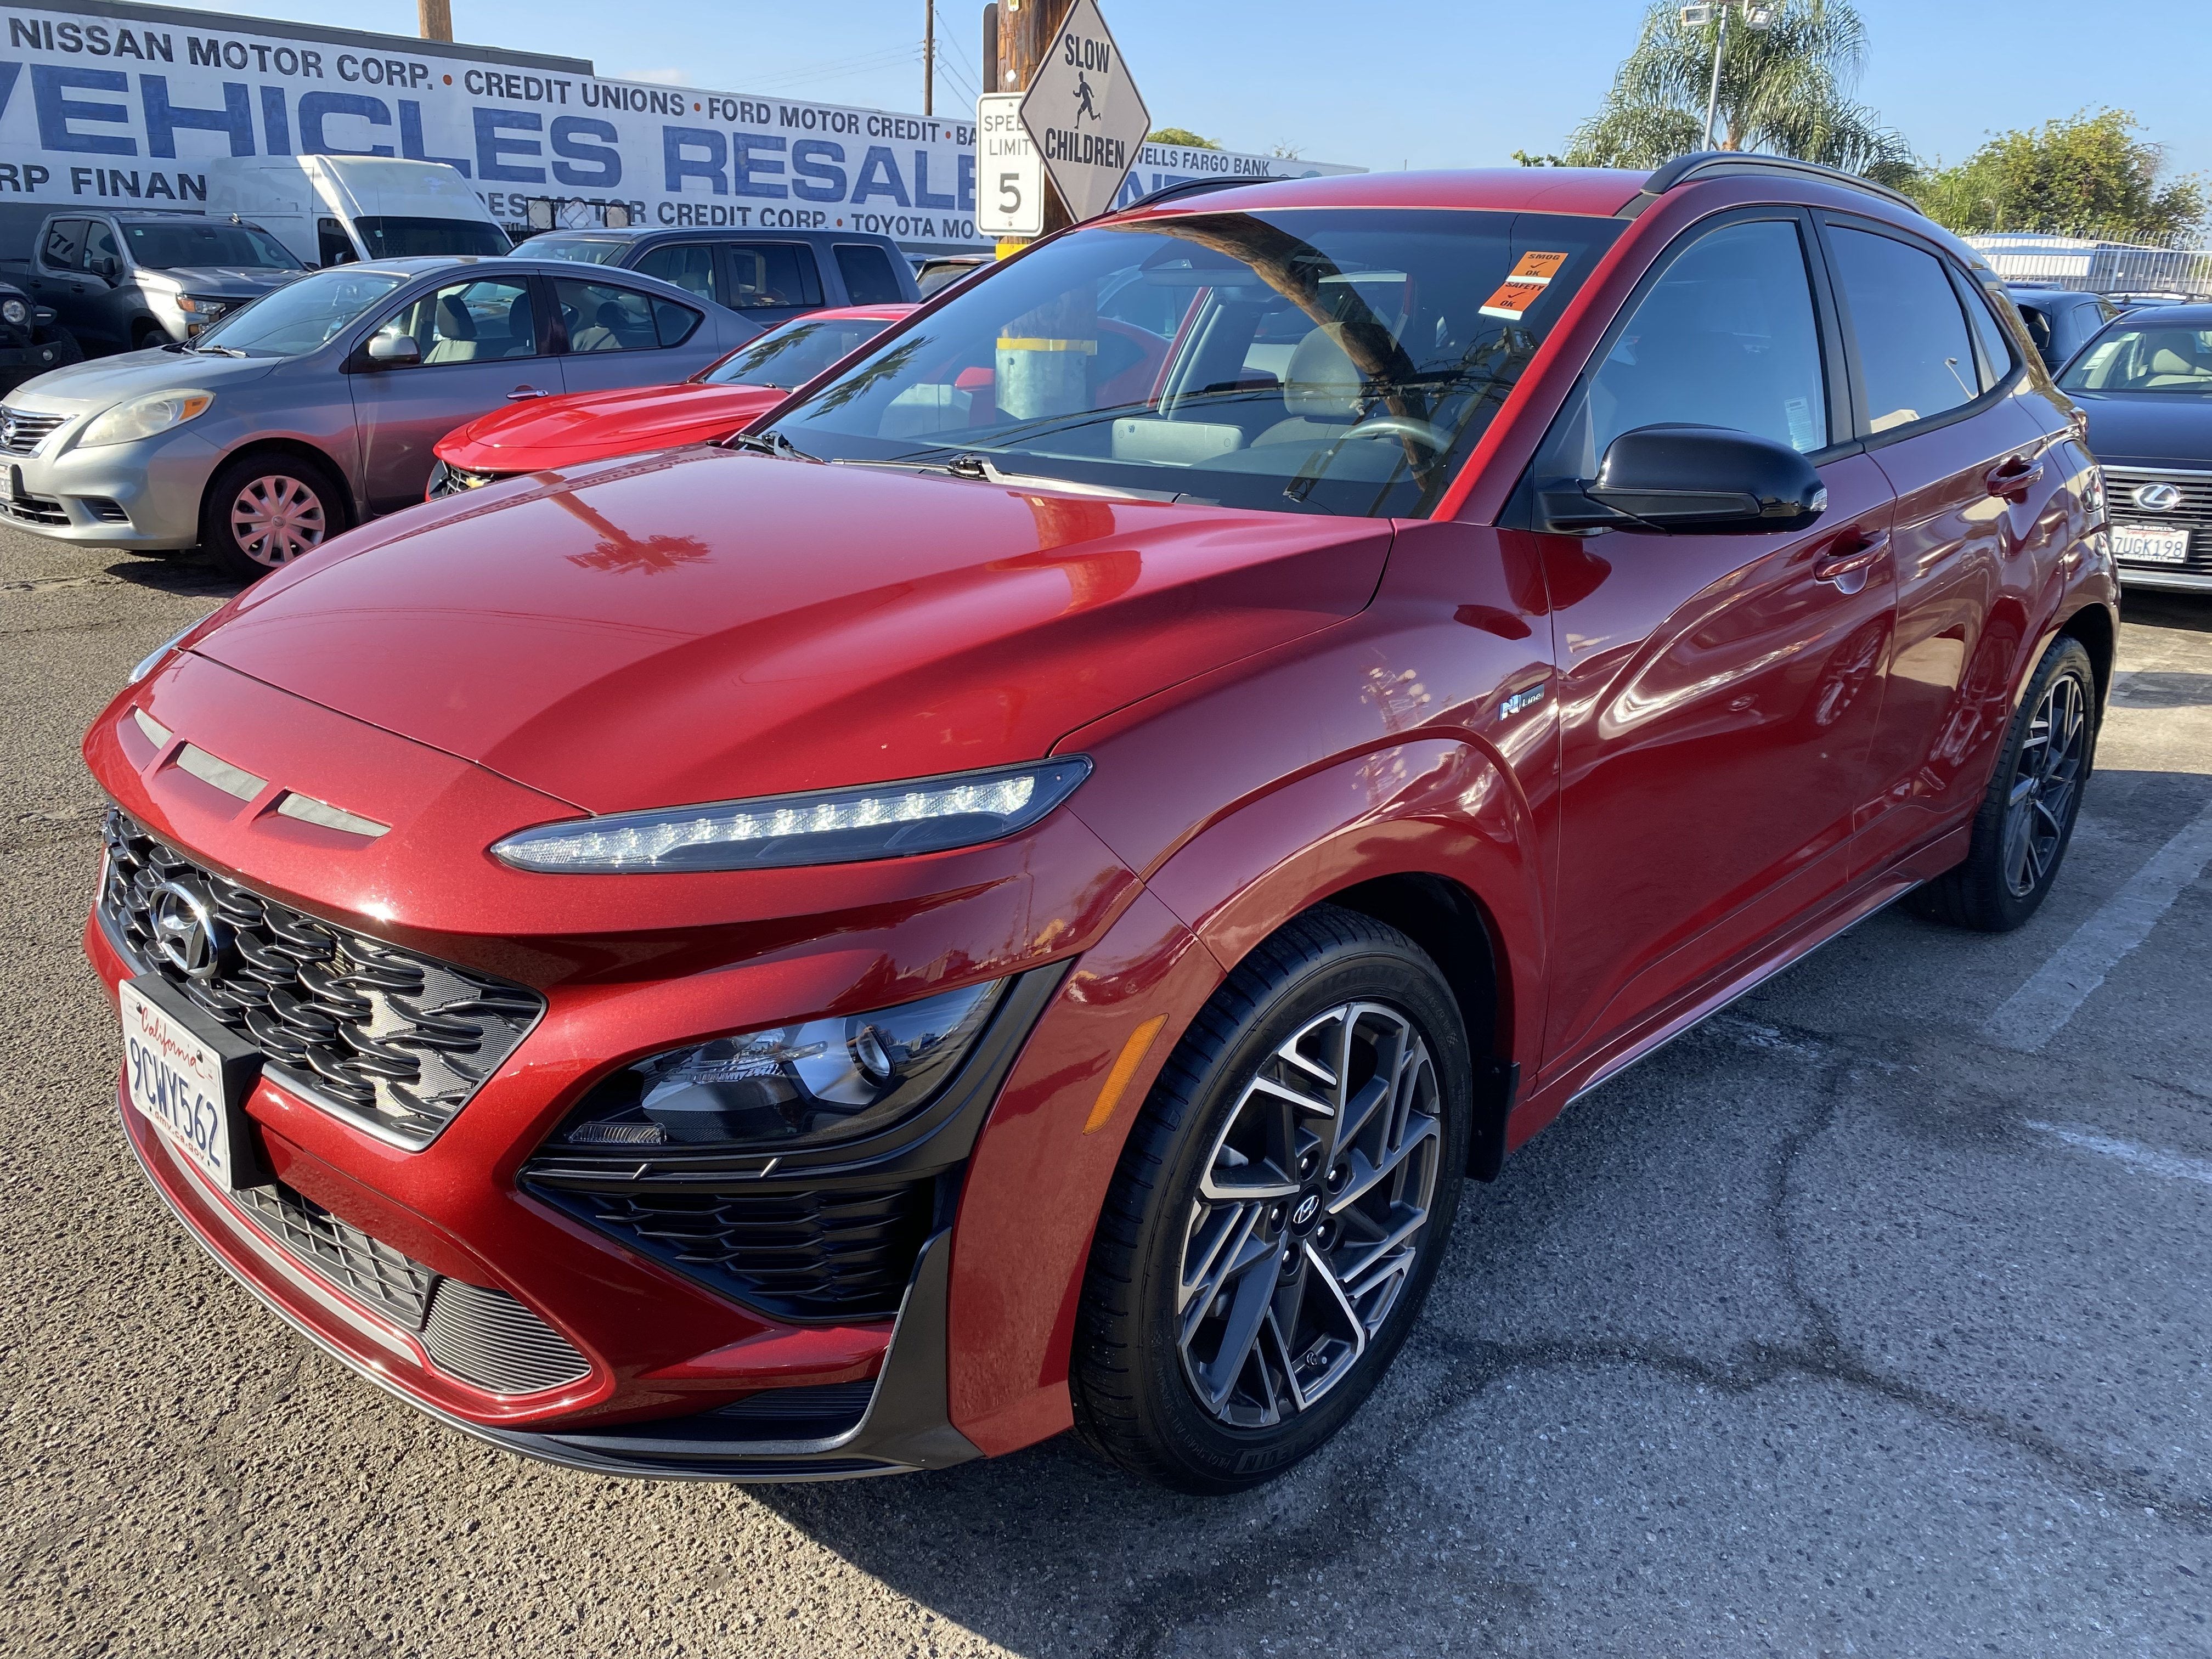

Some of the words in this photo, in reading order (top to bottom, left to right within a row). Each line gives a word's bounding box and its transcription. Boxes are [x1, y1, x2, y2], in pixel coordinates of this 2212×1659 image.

[1064, 33, 1110, 74] SLOW
[8, 17, 174, 64] NISSAN
[187, 36, 324, 79] MOTOR
[336, 54, 433, 91] CORP.
[464, 69, 571, 105] CREDIT
[582, 83, 685, 117] UNIONS
[708, 97, 771, 125] FORD
[779, 105, 859, 136] MOTOR
[867, 115, 941, 143] CREDIT
[984, 115, 1025, 132] SPEE
[990, 138, 1030, 155] LIMIT
[1045, 127, 1125, 170] CHILDREN
[1183, 151, 1229, 173] FARGO
[1234, 157, 1270, 177] BANK
[998, 172, 1022, 214] 5
[658, 201, 752, 227] CREDIT
[851, 213, 935, 236] TOYOTA
[1505, 281, 1545, 292] SAFETY
[2115, 537, 2183, 556] 7UGK198
[141, 1006, 205, 1079] California
[129, 1036, 220, 1168] 9CWY562
[154, 1110, 205, 1161] dmv.ca.gov
